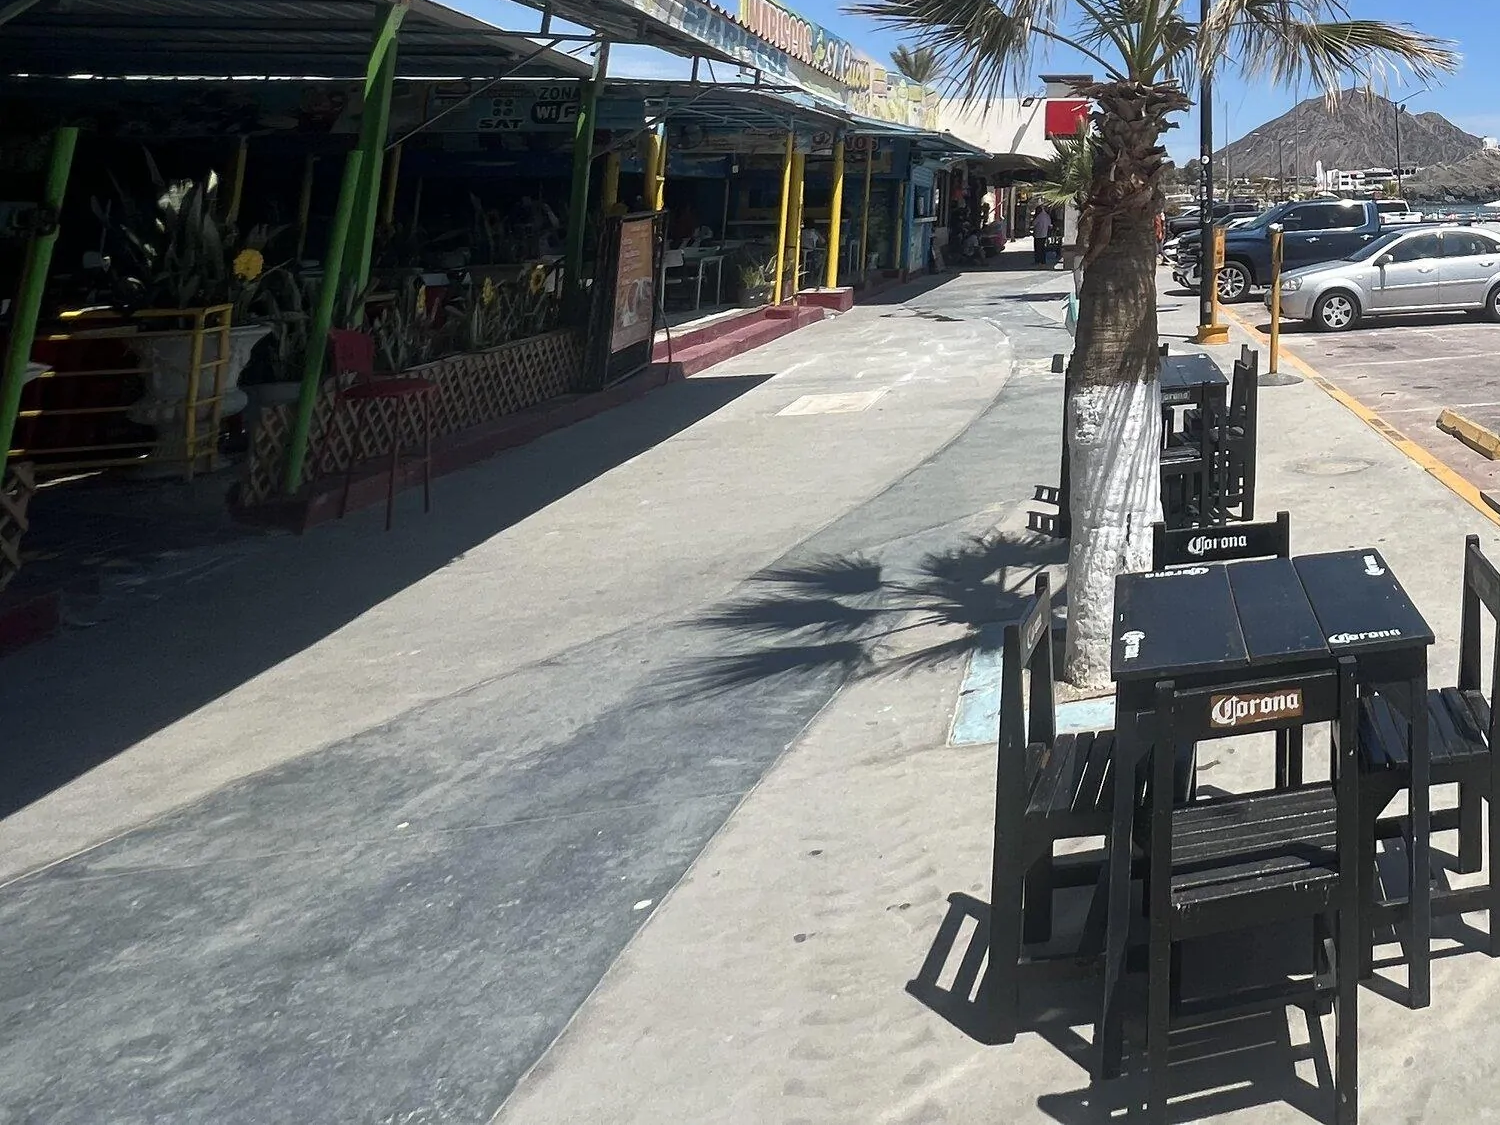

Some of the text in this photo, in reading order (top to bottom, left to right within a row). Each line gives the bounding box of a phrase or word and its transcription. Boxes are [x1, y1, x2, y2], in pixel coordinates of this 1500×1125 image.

[539, 86, 580, 100] ZONA
[536, 103, 578, 121] WiF
[478, 118, 524, 130] SAT
[1162, 391, 1189, 402] orona
[1187, 534, 1248, 557] Corona
[1144, 566, 1210, 579] Corona
[1328, 628, 1402, 644] Corona
[1211, 692, 1300, 726] Corona
